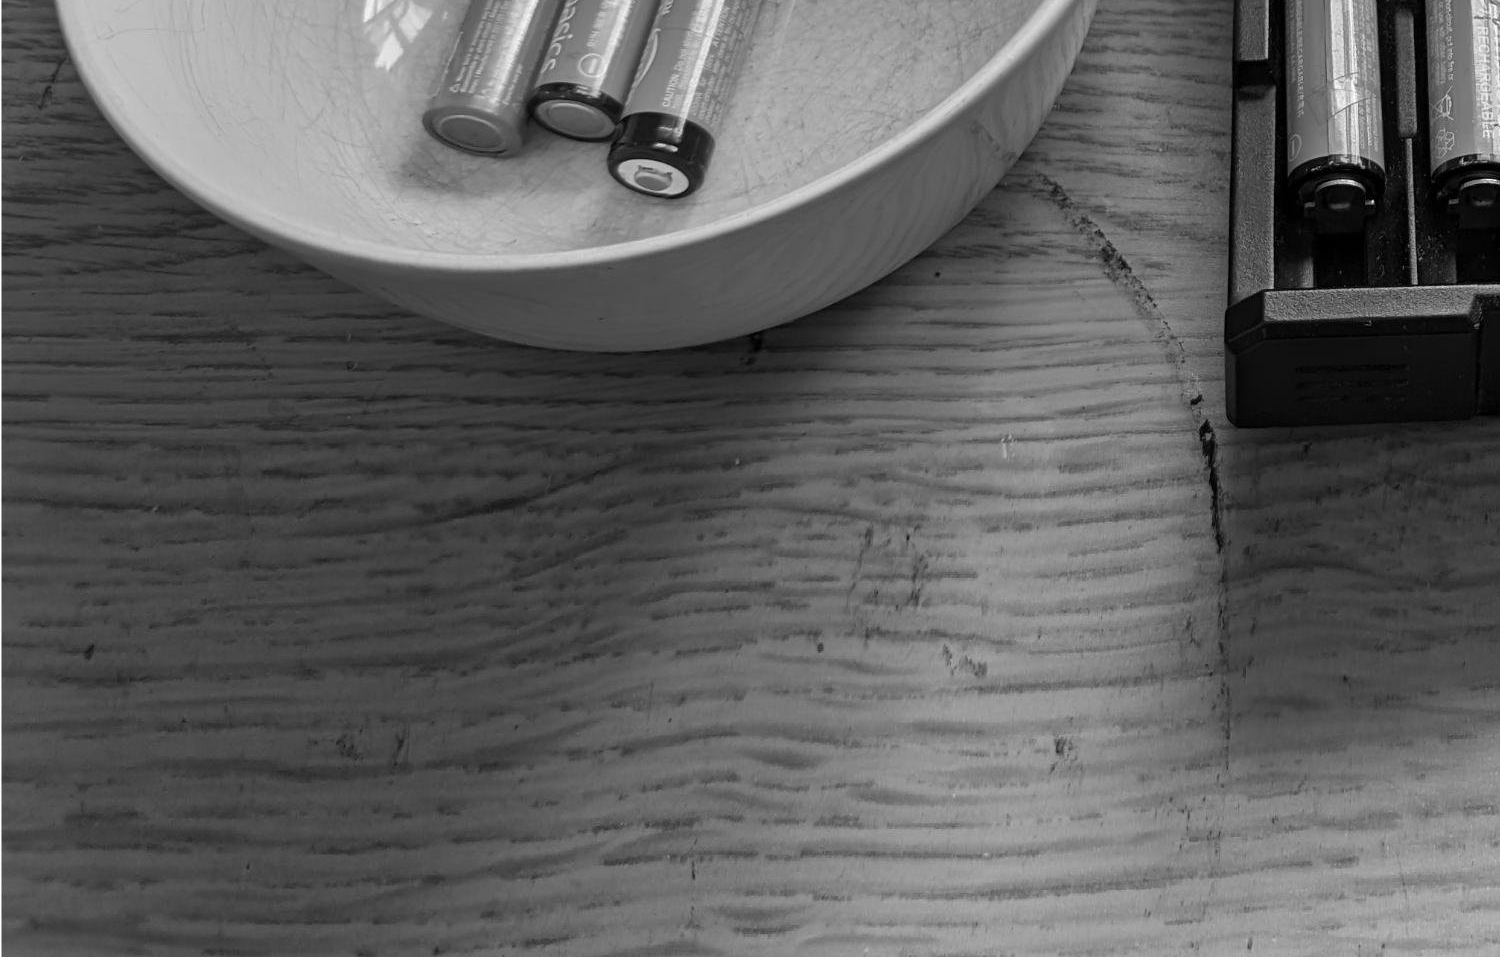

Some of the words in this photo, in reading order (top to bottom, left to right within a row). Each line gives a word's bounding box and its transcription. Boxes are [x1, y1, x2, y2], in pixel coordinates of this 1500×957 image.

[1445, 35, 1453, 46] put
[674, 60, 683, 70] Do
[1474, 25, 1496, 138] RECHARGEABLE
